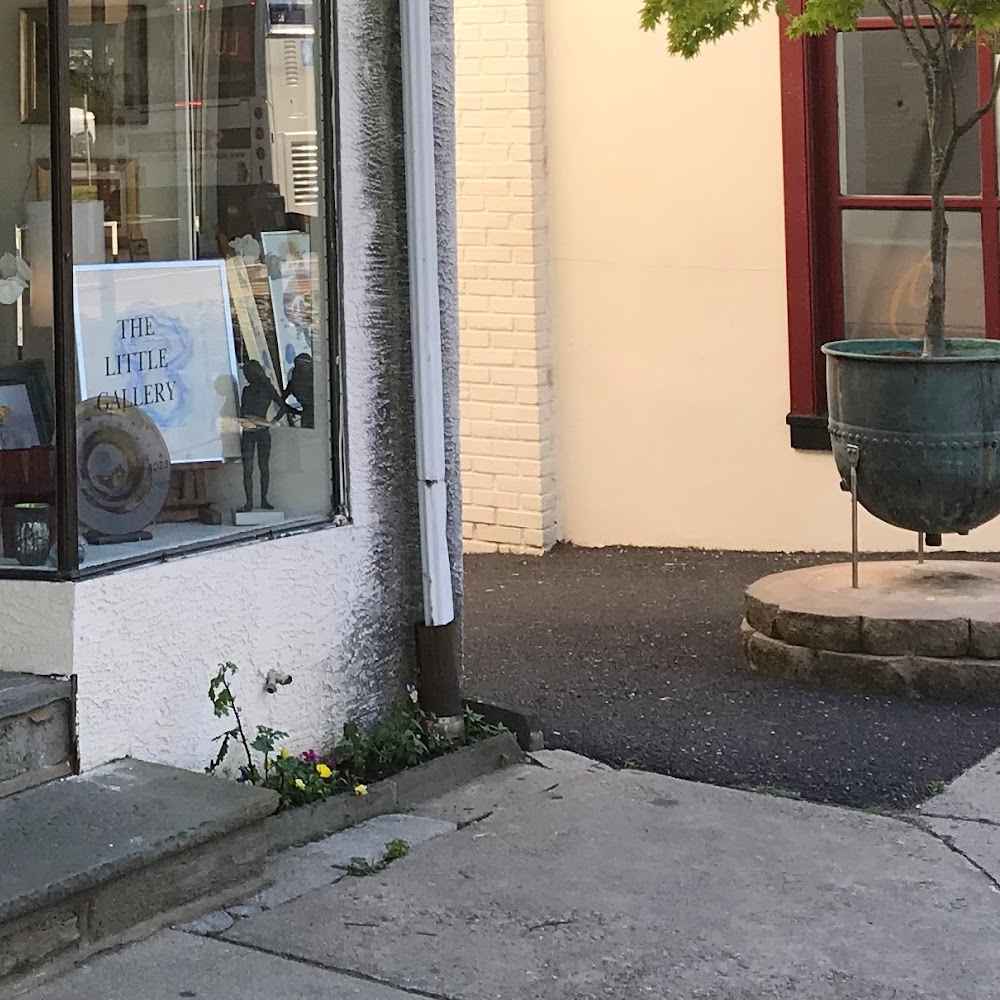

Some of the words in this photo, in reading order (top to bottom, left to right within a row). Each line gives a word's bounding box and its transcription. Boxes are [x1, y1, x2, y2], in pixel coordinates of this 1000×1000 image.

[117, 316, 155, 339] THE
[104, 348, 169, 377] LITTLE
[96, 380, 176, 412] GALLERY
